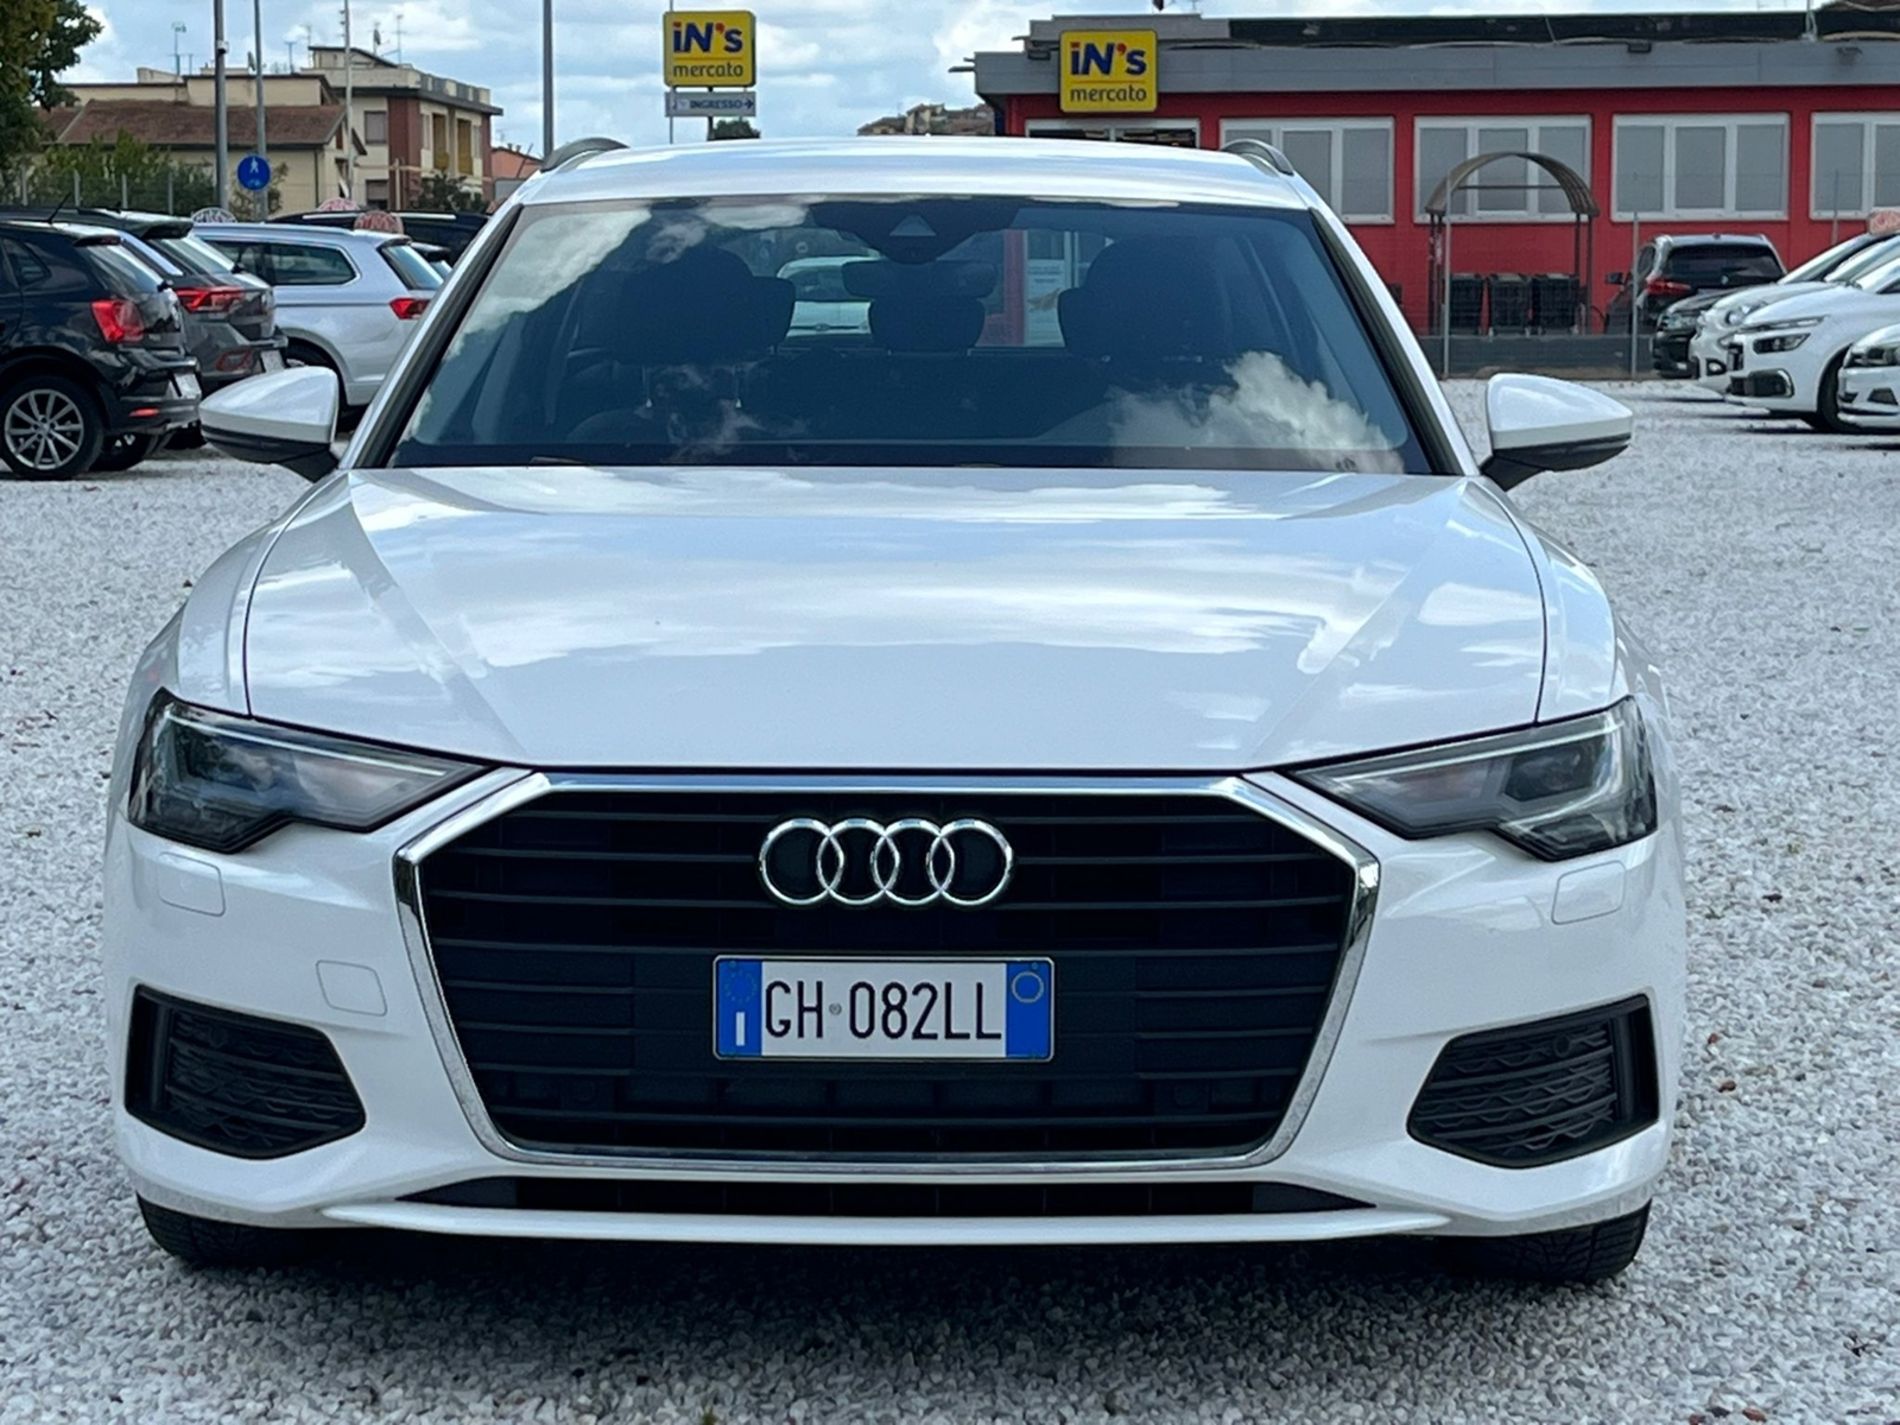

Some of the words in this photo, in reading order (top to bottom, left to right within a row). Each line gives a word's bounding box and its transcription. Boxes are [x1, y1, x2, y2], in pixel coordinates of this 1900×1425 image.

[672, 22, 743, 53] iN's
[673, 62, 744, 78] mercato
[1070, 42, 1146, 75] iN's
[690, 99, 742, 109] INGRESSO
[1070, 85, 1147, 102] mercato
[765, 980, 823, 1039] GH
[849, 981, 1002, 1040] 082LL
